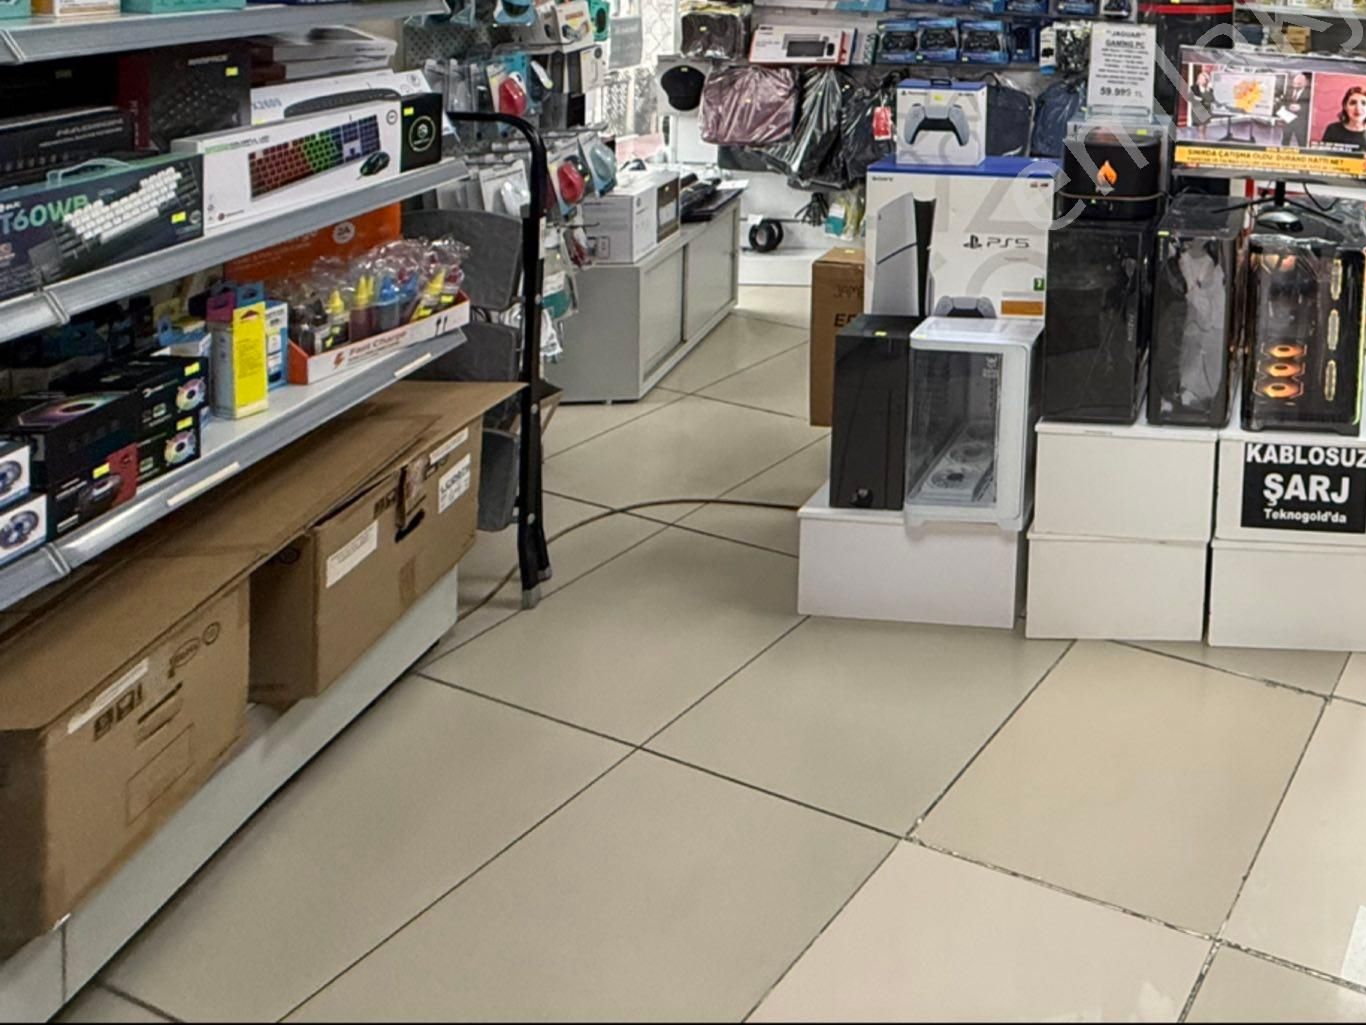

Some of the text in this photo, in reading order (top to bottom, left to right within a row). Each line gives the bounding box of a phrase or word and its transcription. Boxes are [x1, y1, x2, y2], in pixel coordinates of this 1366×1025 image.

[1105, 39, 1134, 48] GAMING
[987, 236, 1030, 249] PS5
[349, 331, 407, 356] Fast Charge
[1263, 472, 1350, 508] ŞARJ
[1263, 507, 1347, 524] Teknogold'da
